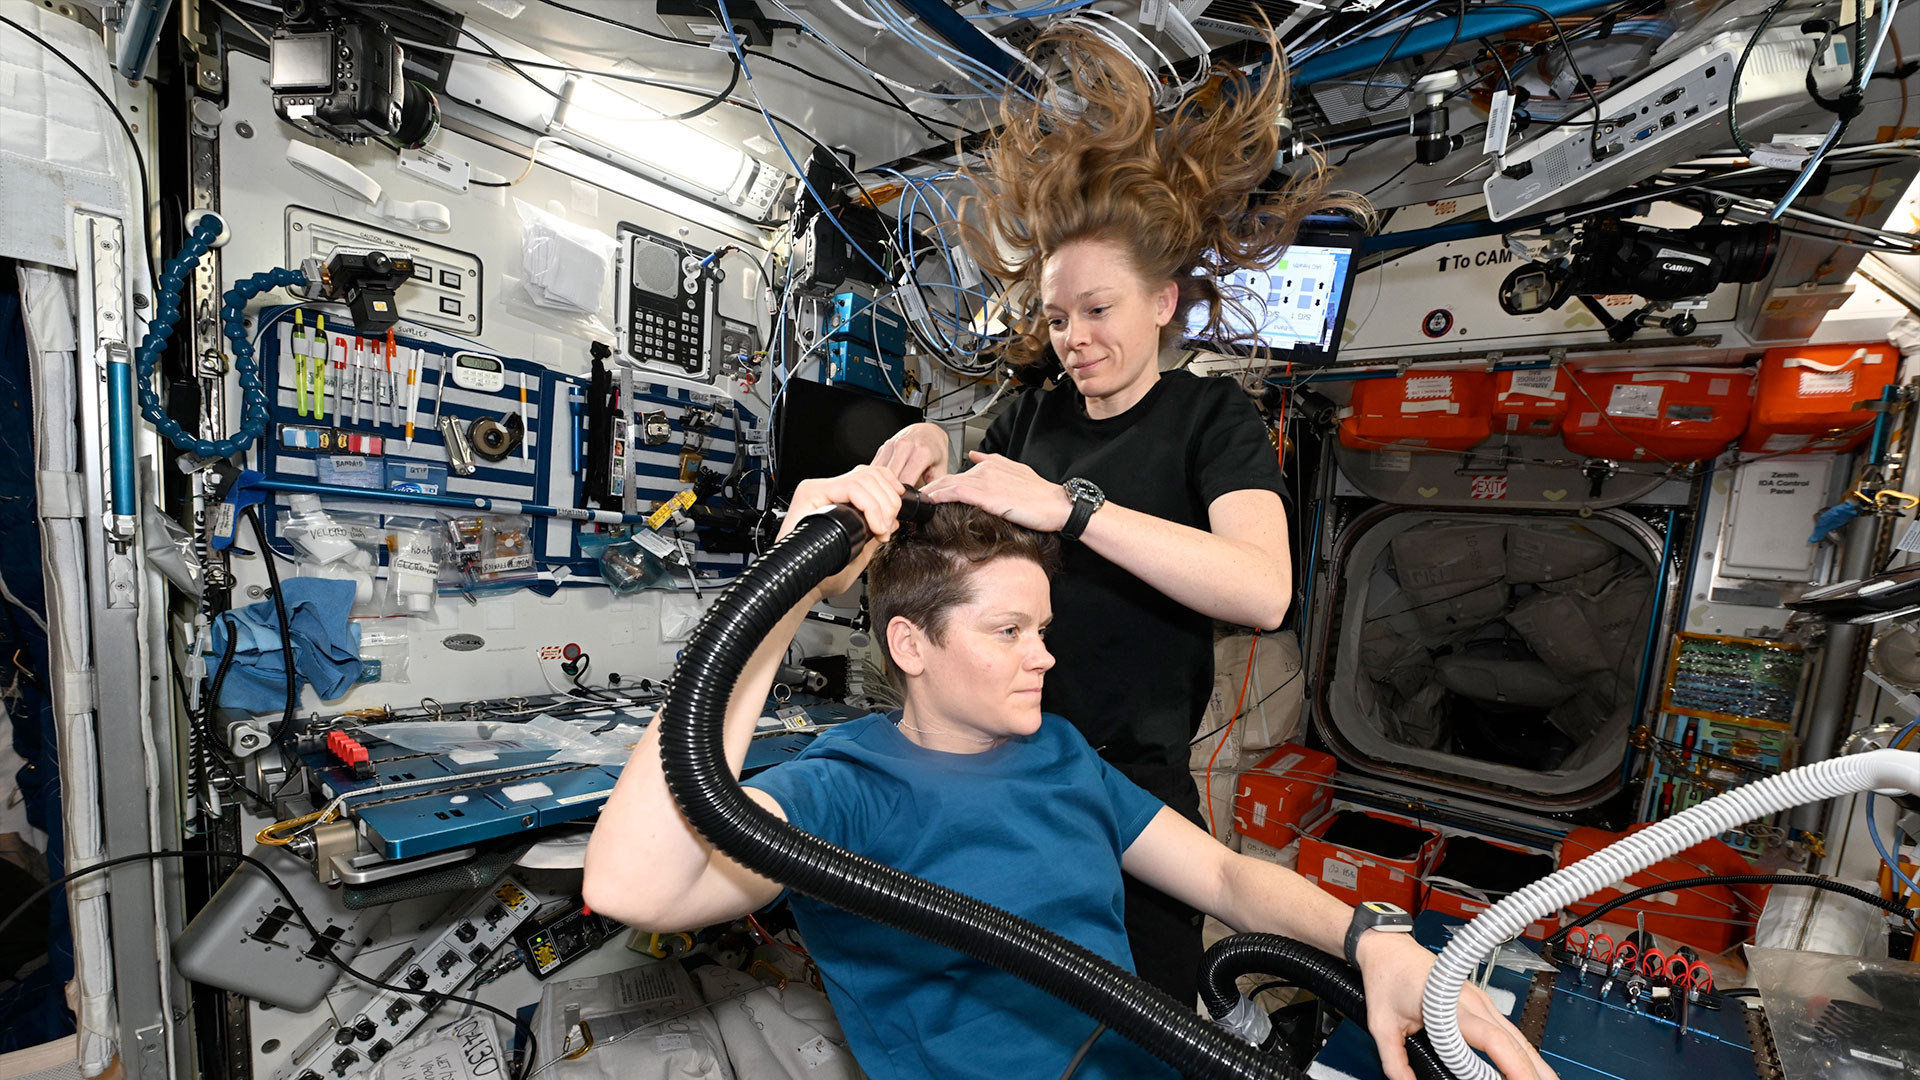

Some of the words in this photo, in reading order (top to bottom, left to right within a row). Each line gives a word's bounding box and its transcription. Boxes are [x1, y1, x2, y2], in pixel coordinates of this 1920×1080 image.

[360, 232, 382, 242] CAUTION
[1453, 255, 1470, 270] To
[1475, 248, 1513, 267] CAM
[1662, 262, 1694, 273] Canon
[1771, 471, 1799, 479] Zenith
[1476, 480, 1501, 493] EXIT
[490, 936, 501, 946] VDC
[443, 981, 454, 992] VDC
[392, 1030, 403, 1041] VDC
